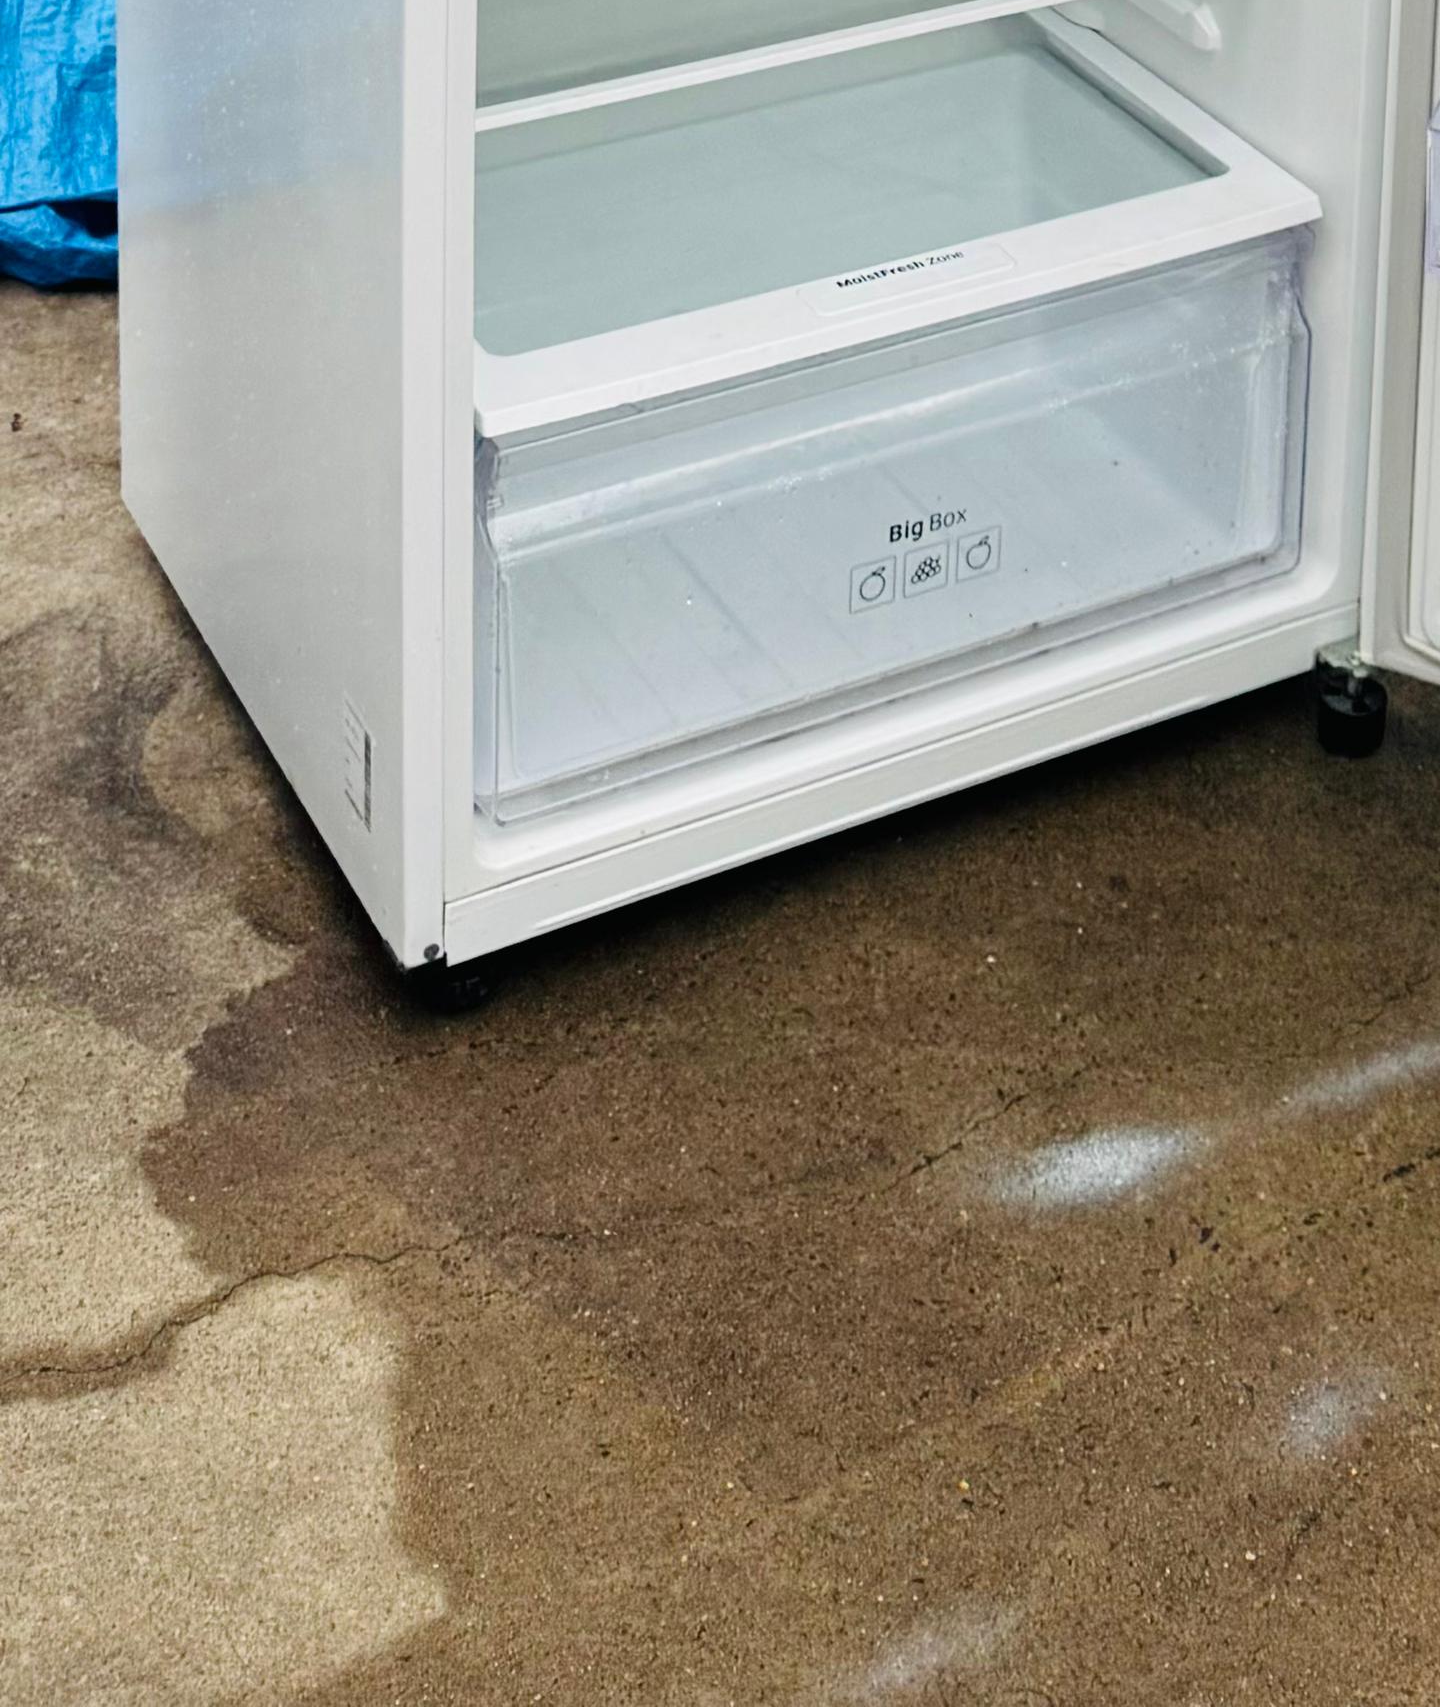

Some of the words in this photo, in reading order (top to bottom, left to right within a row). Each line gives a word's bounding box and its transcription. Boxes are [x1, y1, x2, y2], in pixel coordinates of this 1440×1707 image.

[836, 260, 925, 289] MoistFresh
[927, 250, 964, 267] Zone
[888, 519, 924, 544] Big
[929, 507, 969, 532] Box
